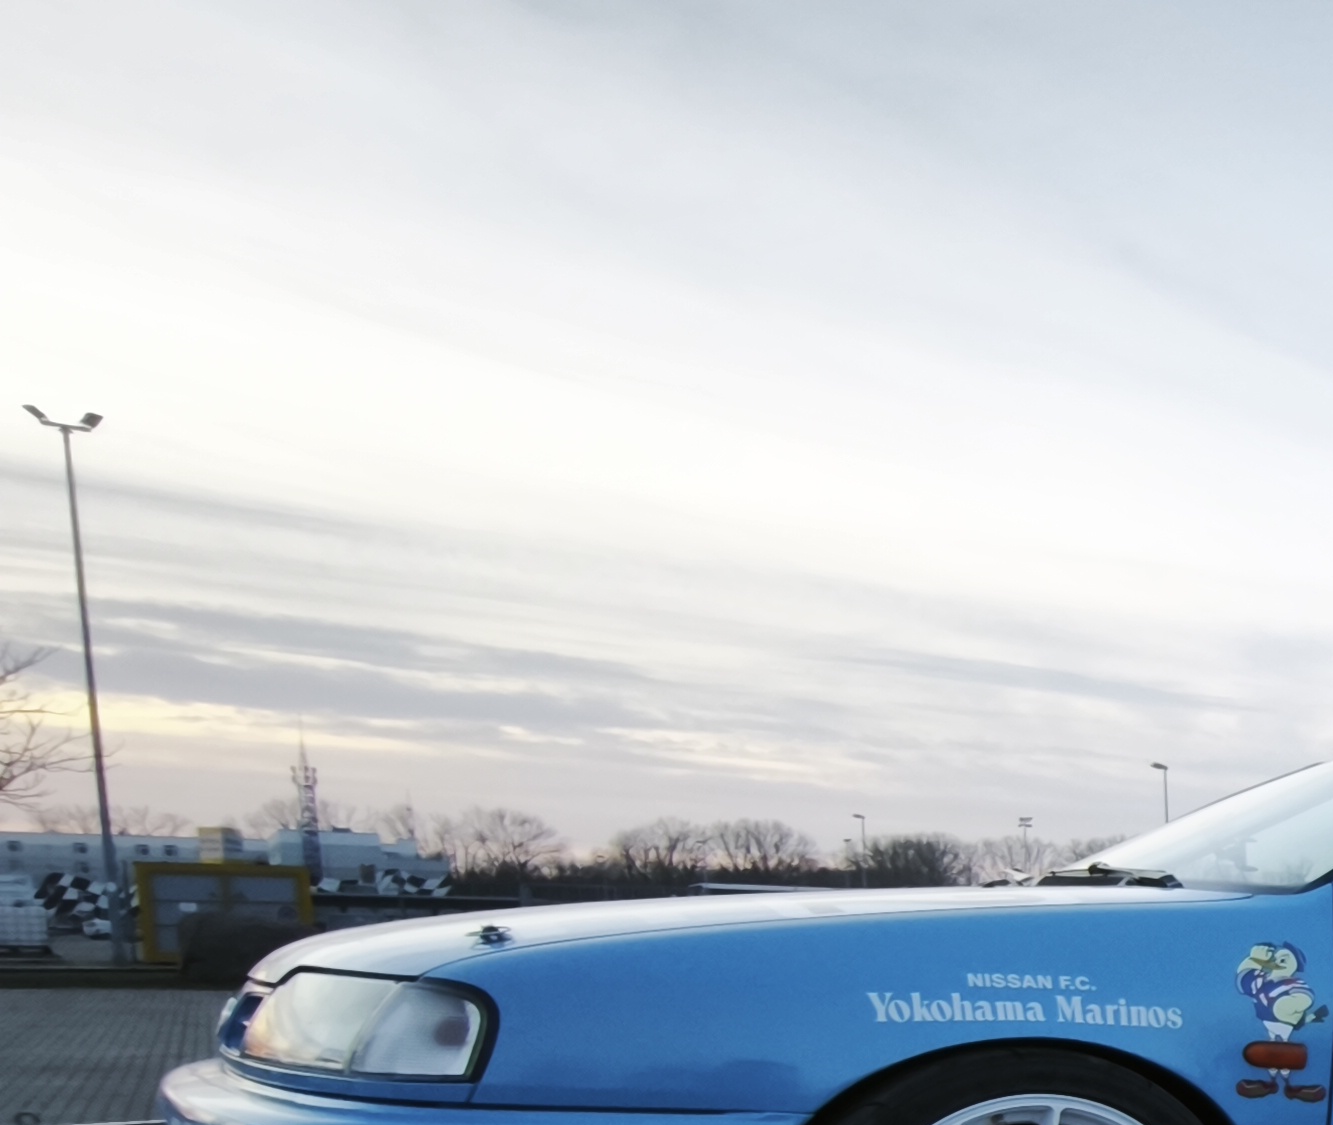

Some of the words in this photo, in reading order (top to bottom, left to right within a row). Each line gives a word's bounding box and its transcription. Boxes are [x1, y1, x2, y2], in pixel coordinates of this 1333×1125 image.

[967, 973, 1053, 989] NISSAN
[1059, 975, 1097, 991] F.C.
[866, 992, 1046, 1023] Yokohama
[1055, 995, 1183, 1029] Marinos
